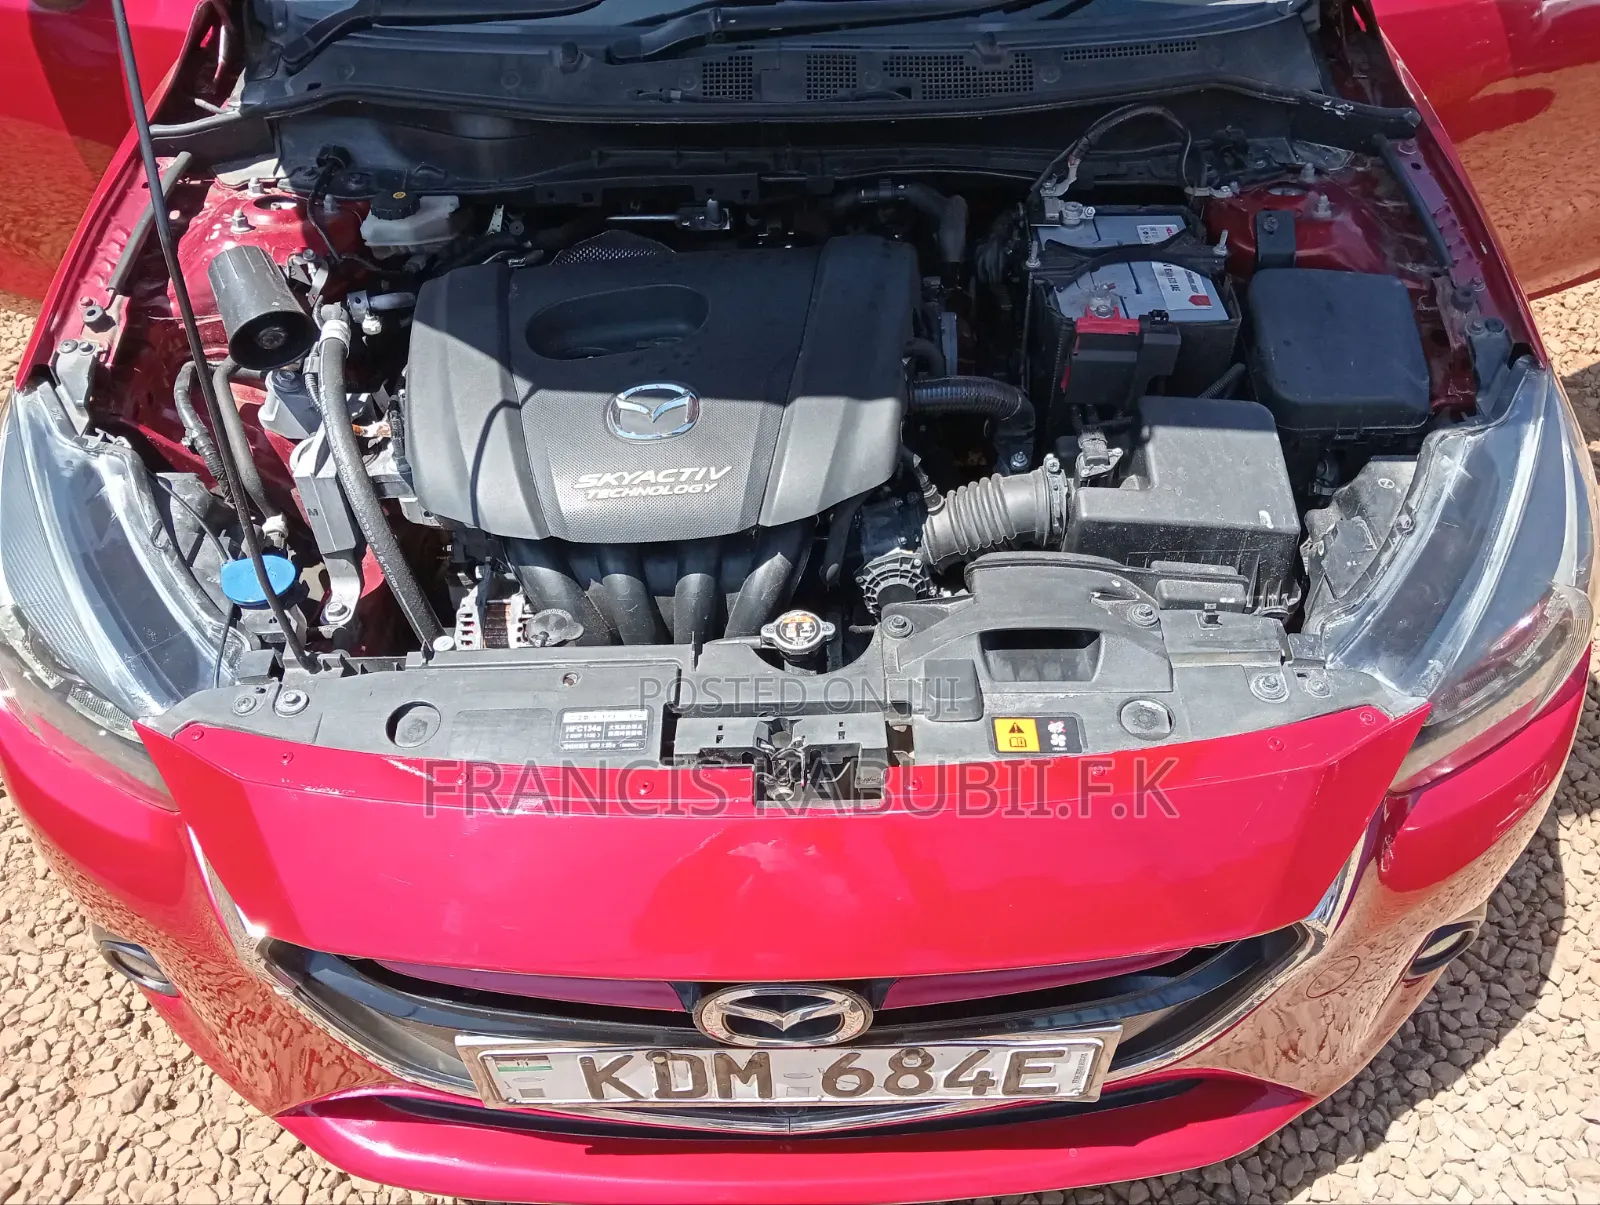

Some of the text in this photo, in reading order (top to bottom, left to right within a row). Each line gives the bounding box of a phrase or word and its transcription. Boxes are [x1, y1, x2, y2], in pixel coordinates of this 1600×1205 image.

[573, 466, 732, 489] SKYACTIV
[586, 483, 718, 500] TECHNOLOGY
[579, 1051, 774, 1099] KDM
[821, 1048, 1066, 1097] 684E
